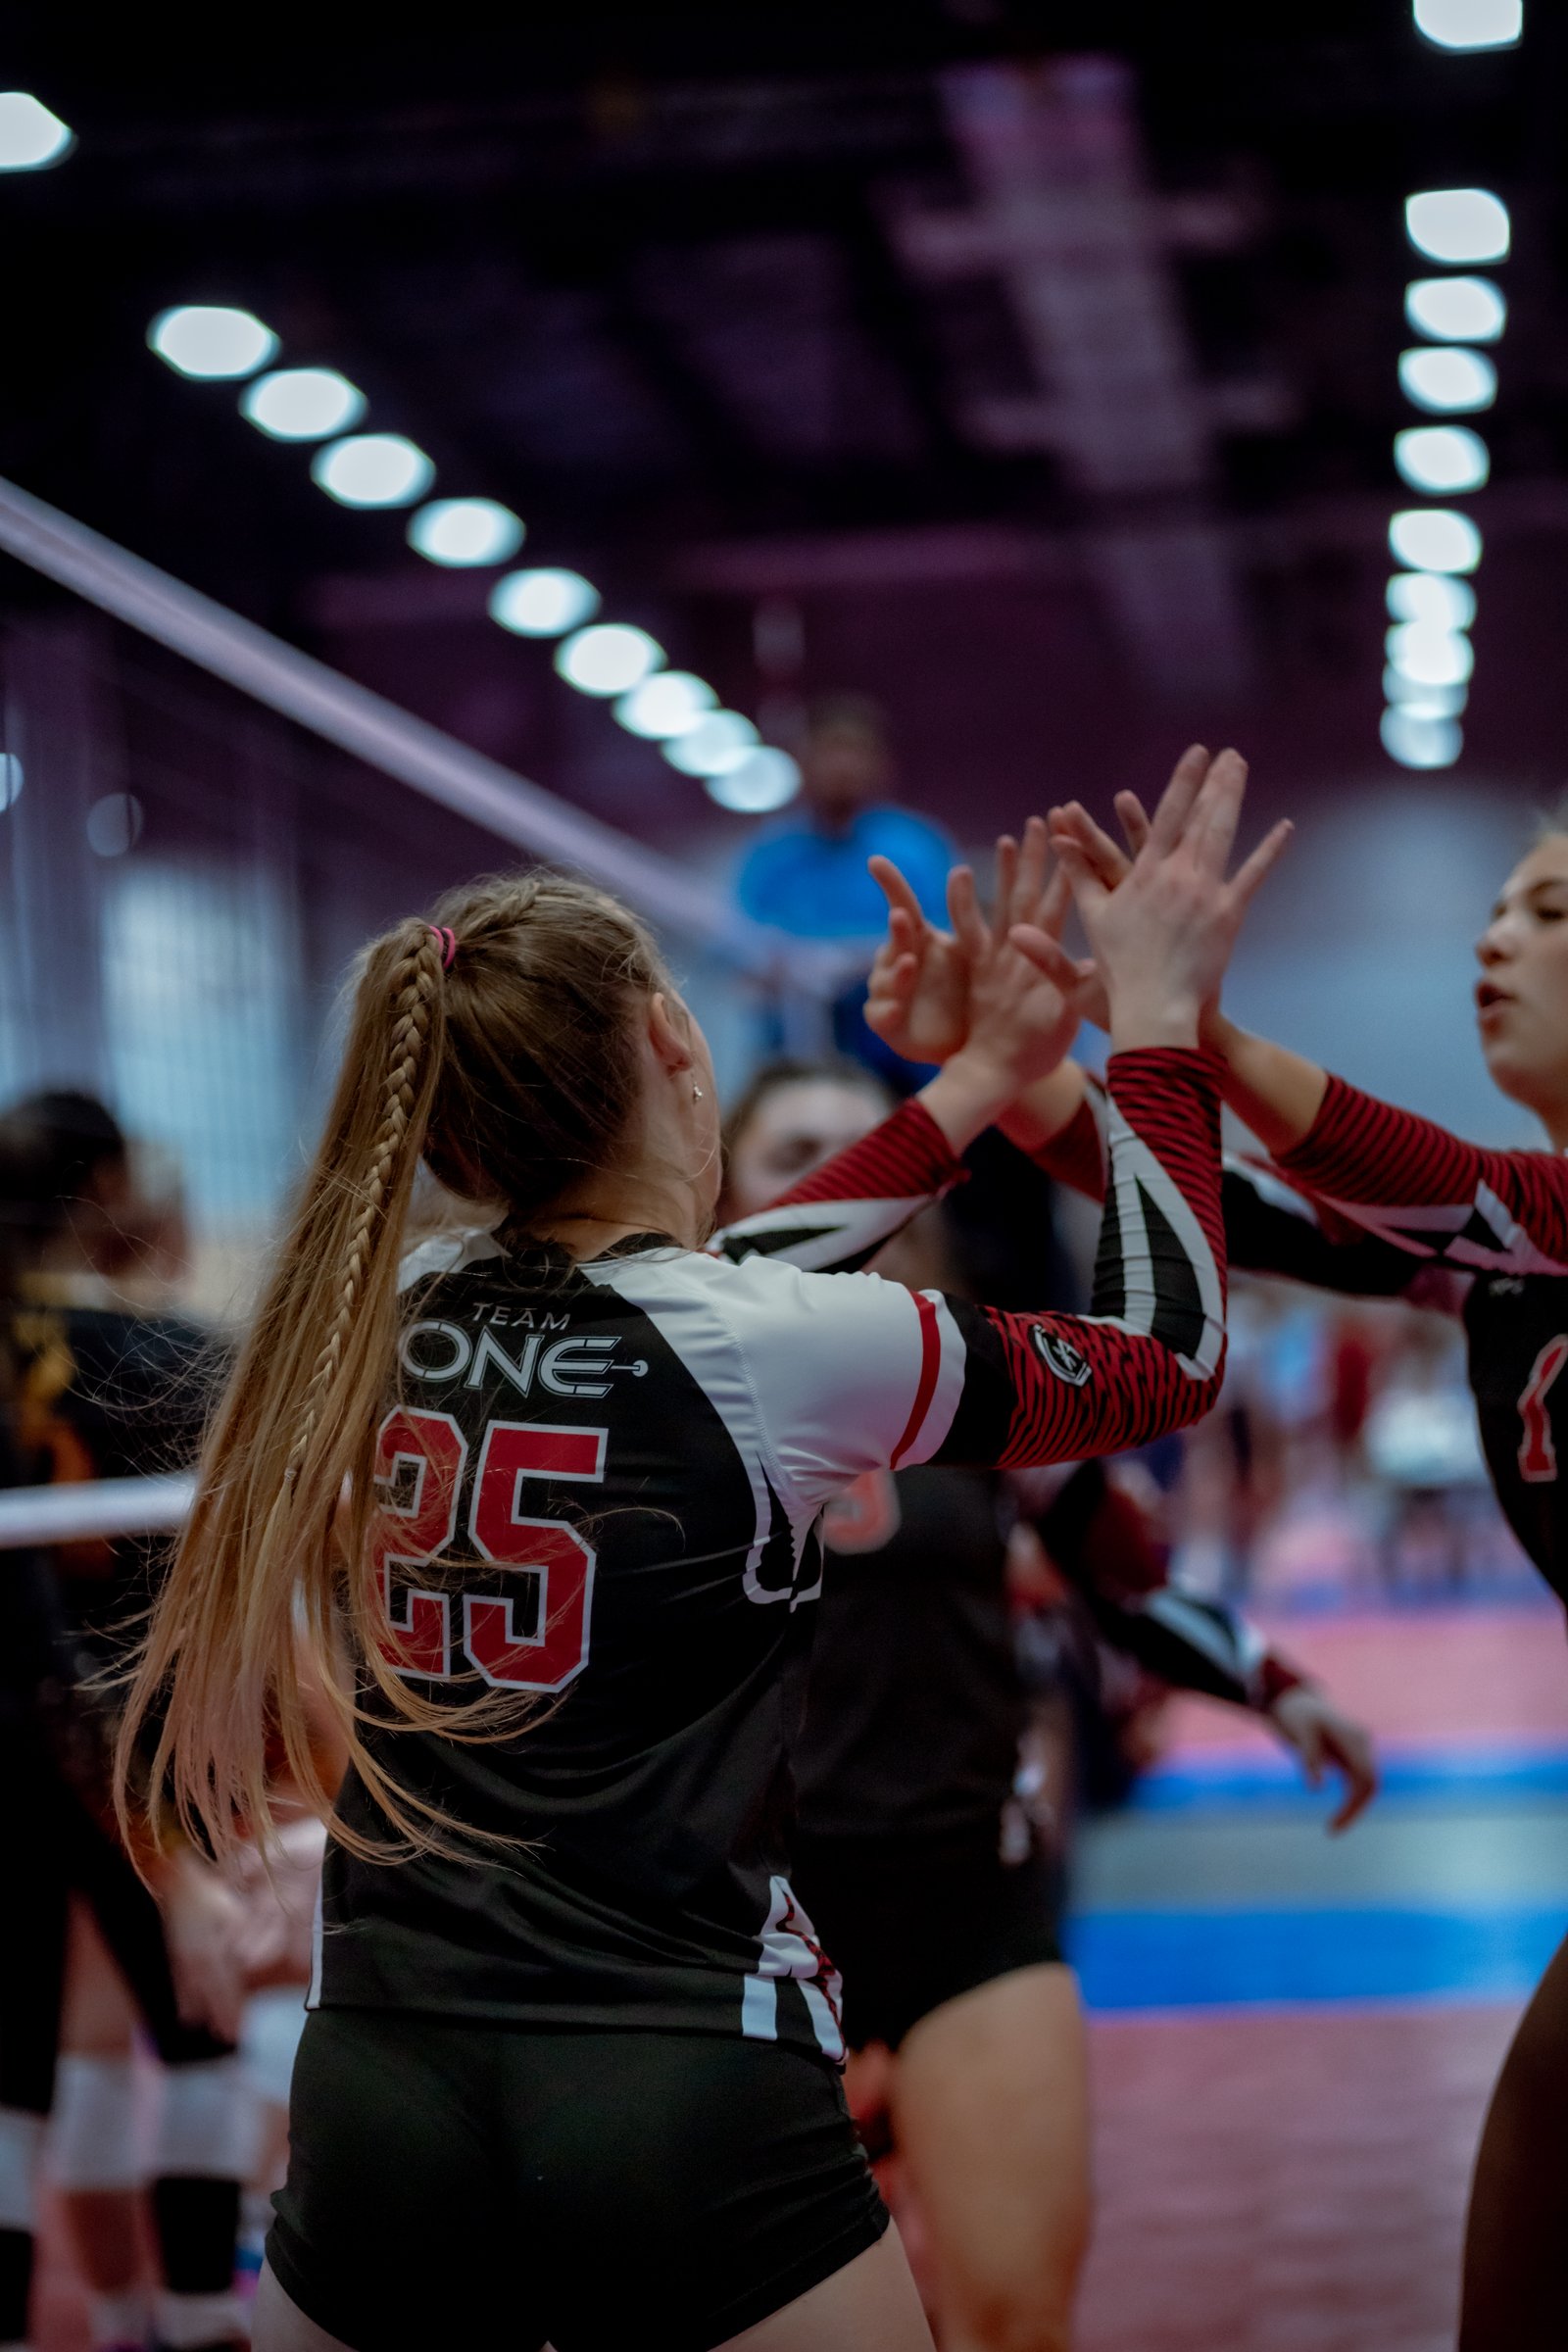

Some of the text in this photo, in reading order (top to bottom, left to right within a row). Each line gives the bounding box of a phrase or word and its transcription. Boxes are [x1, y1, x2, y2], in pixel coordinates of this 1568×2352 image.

[472, 1302, 571, 1332] TEAM
[399, 1318, 624, 1398] ONE
[365, 1403, 610, 1693] 25
